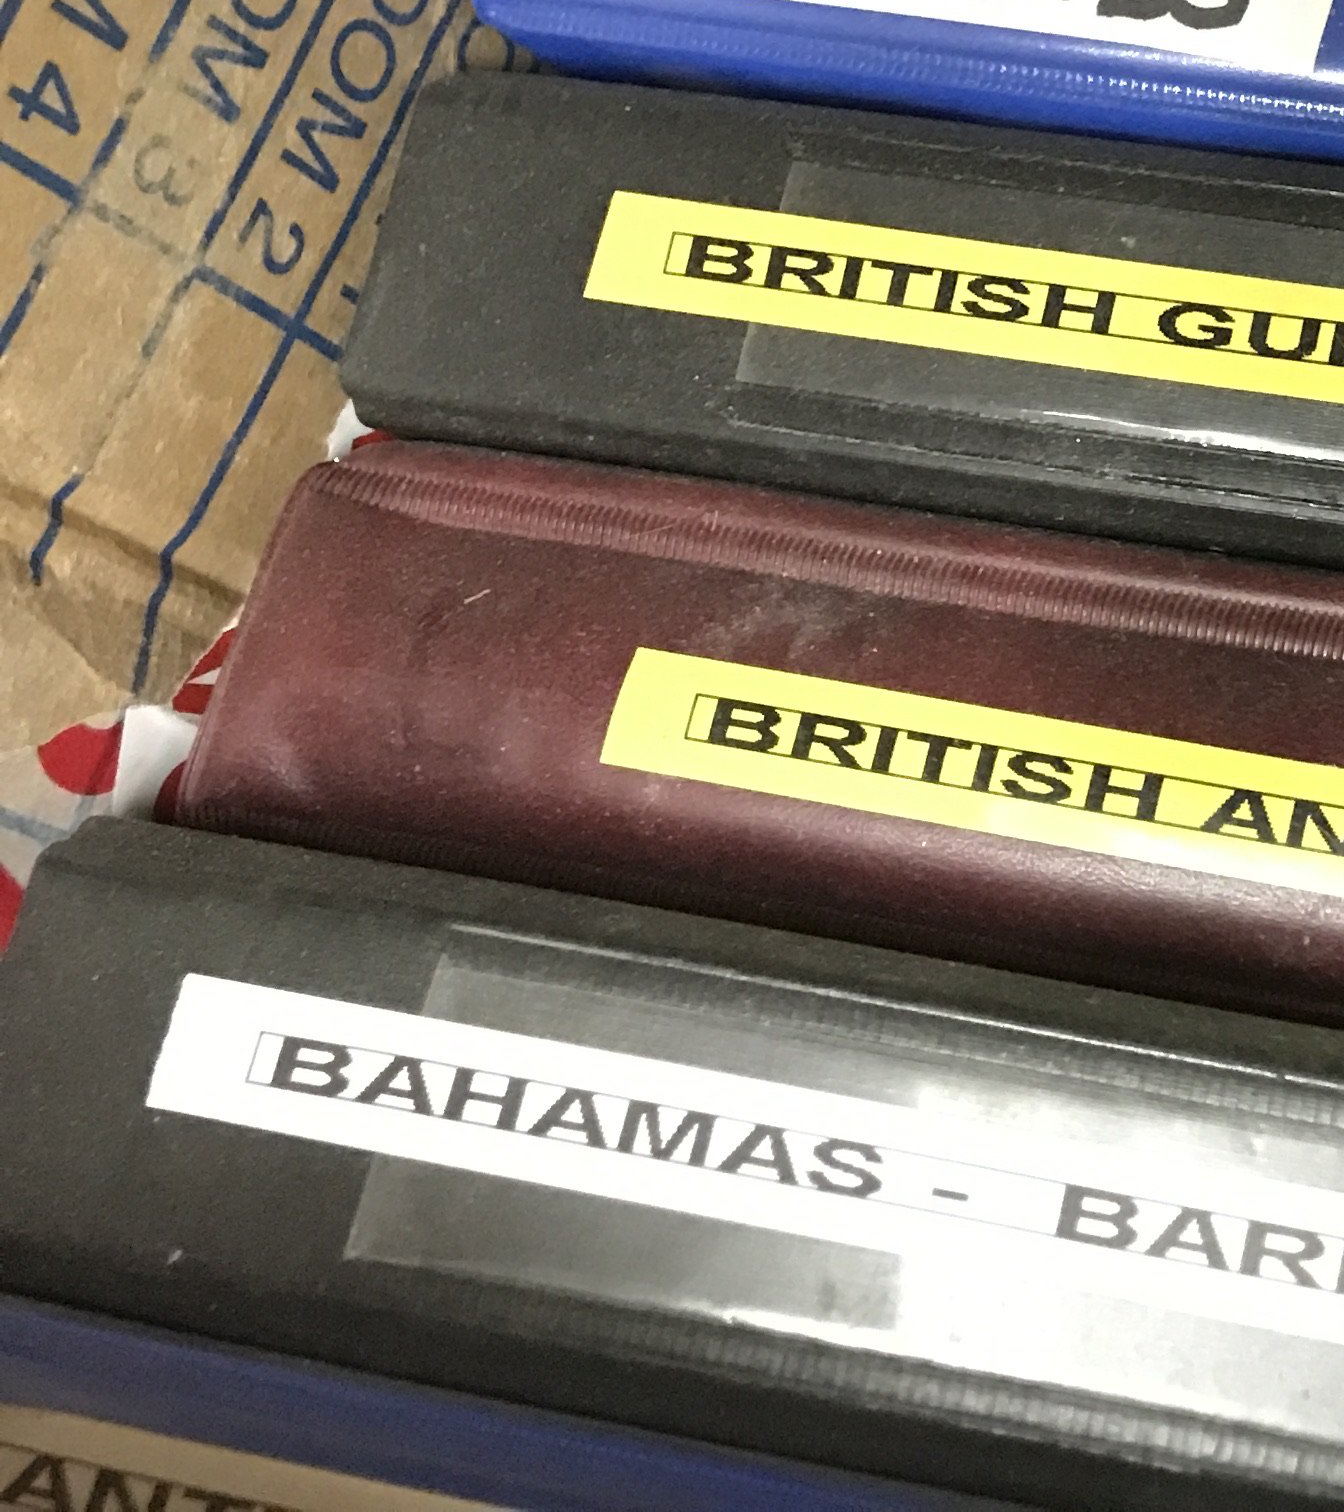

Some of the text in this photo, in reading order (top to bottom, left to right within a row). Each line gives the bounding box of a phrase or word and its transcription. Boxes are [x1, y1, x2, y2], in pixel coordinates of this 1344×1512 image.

[9, 60, 83, 138] 4
[238, 199, 306, 276] 2
[684, 234, 1111, 334] BRITISH
[707, 697, 1167, 822] BRITISH
[269, 1035, 884, 1201] BAHAMAS
